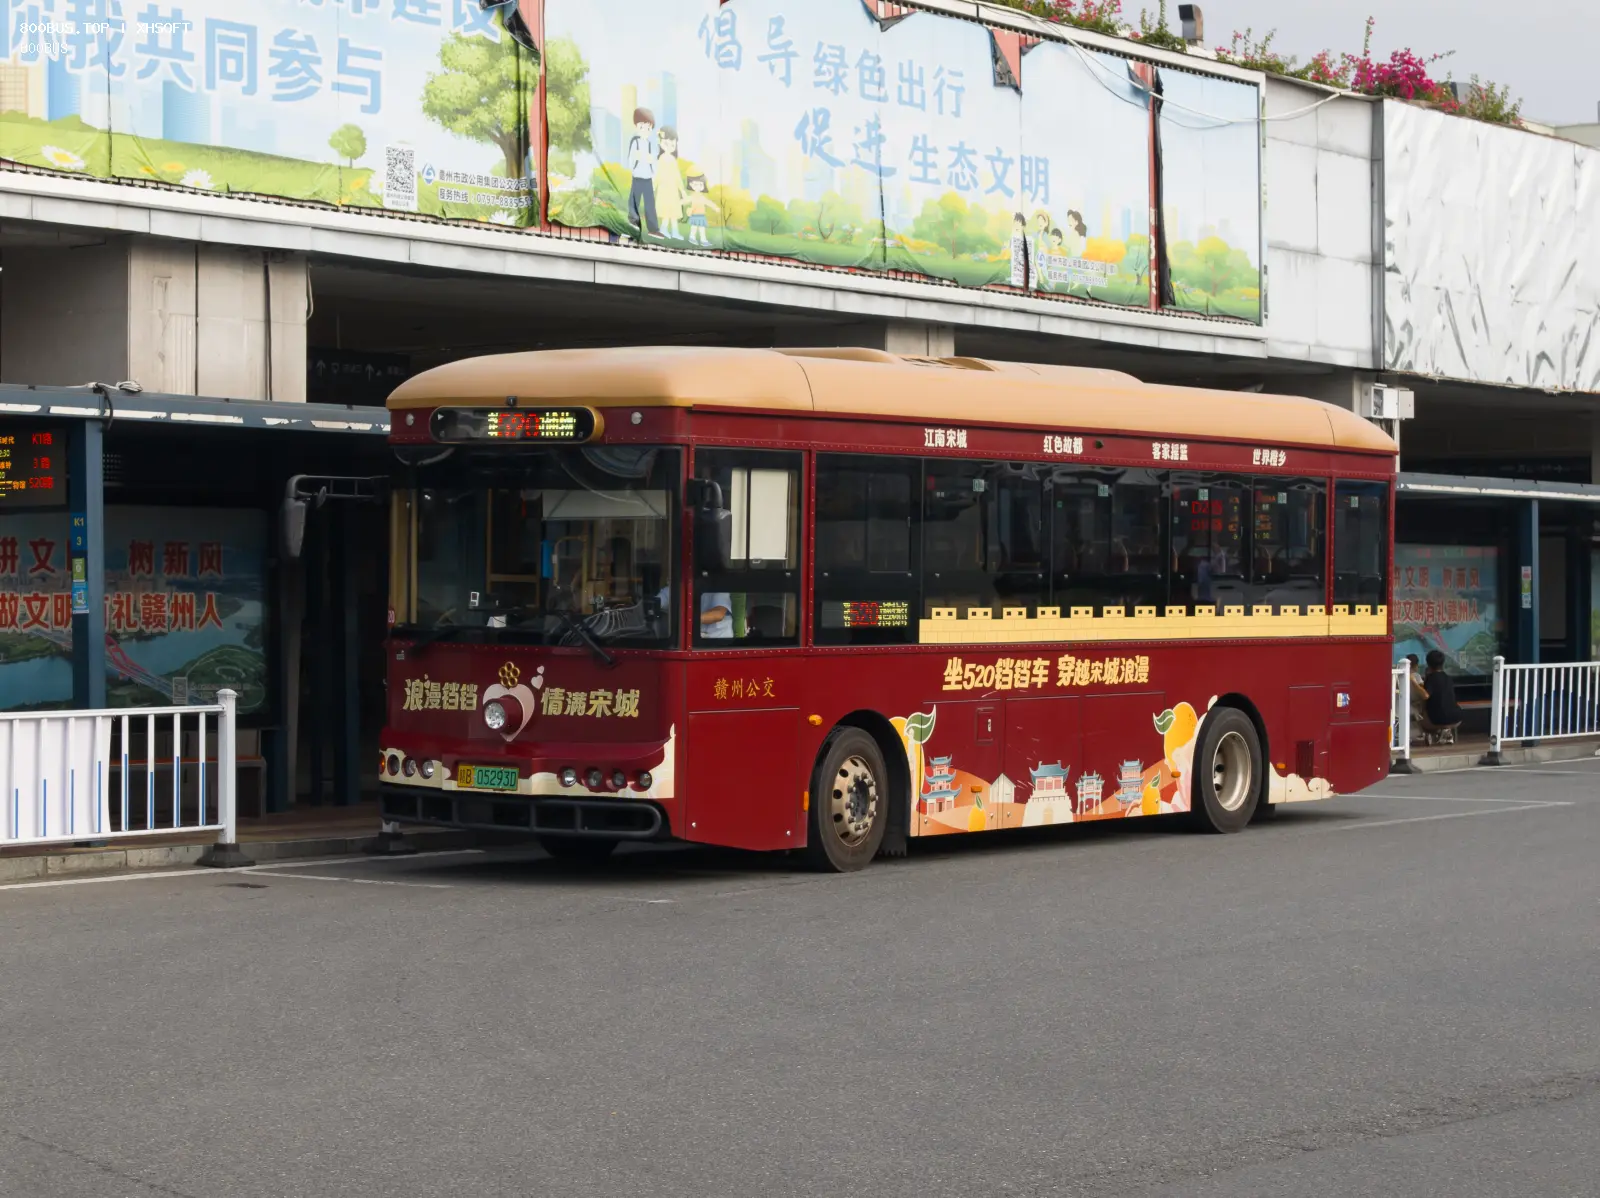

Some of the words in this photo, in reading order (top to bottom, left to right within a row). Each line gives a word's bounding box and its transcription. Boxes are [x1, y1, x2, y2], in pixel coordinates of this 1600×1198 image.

[697, 8, 966, 118] 倡导绿色出行
[794, 106, 1050, 205] 促进生态文明
[924, 427, 968, 449] 江南宋城
[1043, 435, 1084, 455] 红色故都
[1151, 442, 1189, 461] 客家摇篮
[1252, 448, 1287, 467] 世界橙乡
[74, 517, 85, 527] K1
[76, 536, 82, 546] 3
[128, 539, 223, 577] 树新风
[942, 656, 1050, 690] 坐520铛铛车
[1055, 654, 1149, 686] 穿越宋城浪漫
[402, 678, 478, 711] 浪漫铛铛
[541, 687, 640, 718] 情满宋城
[713, 677, 776, 700] 赣州公交
